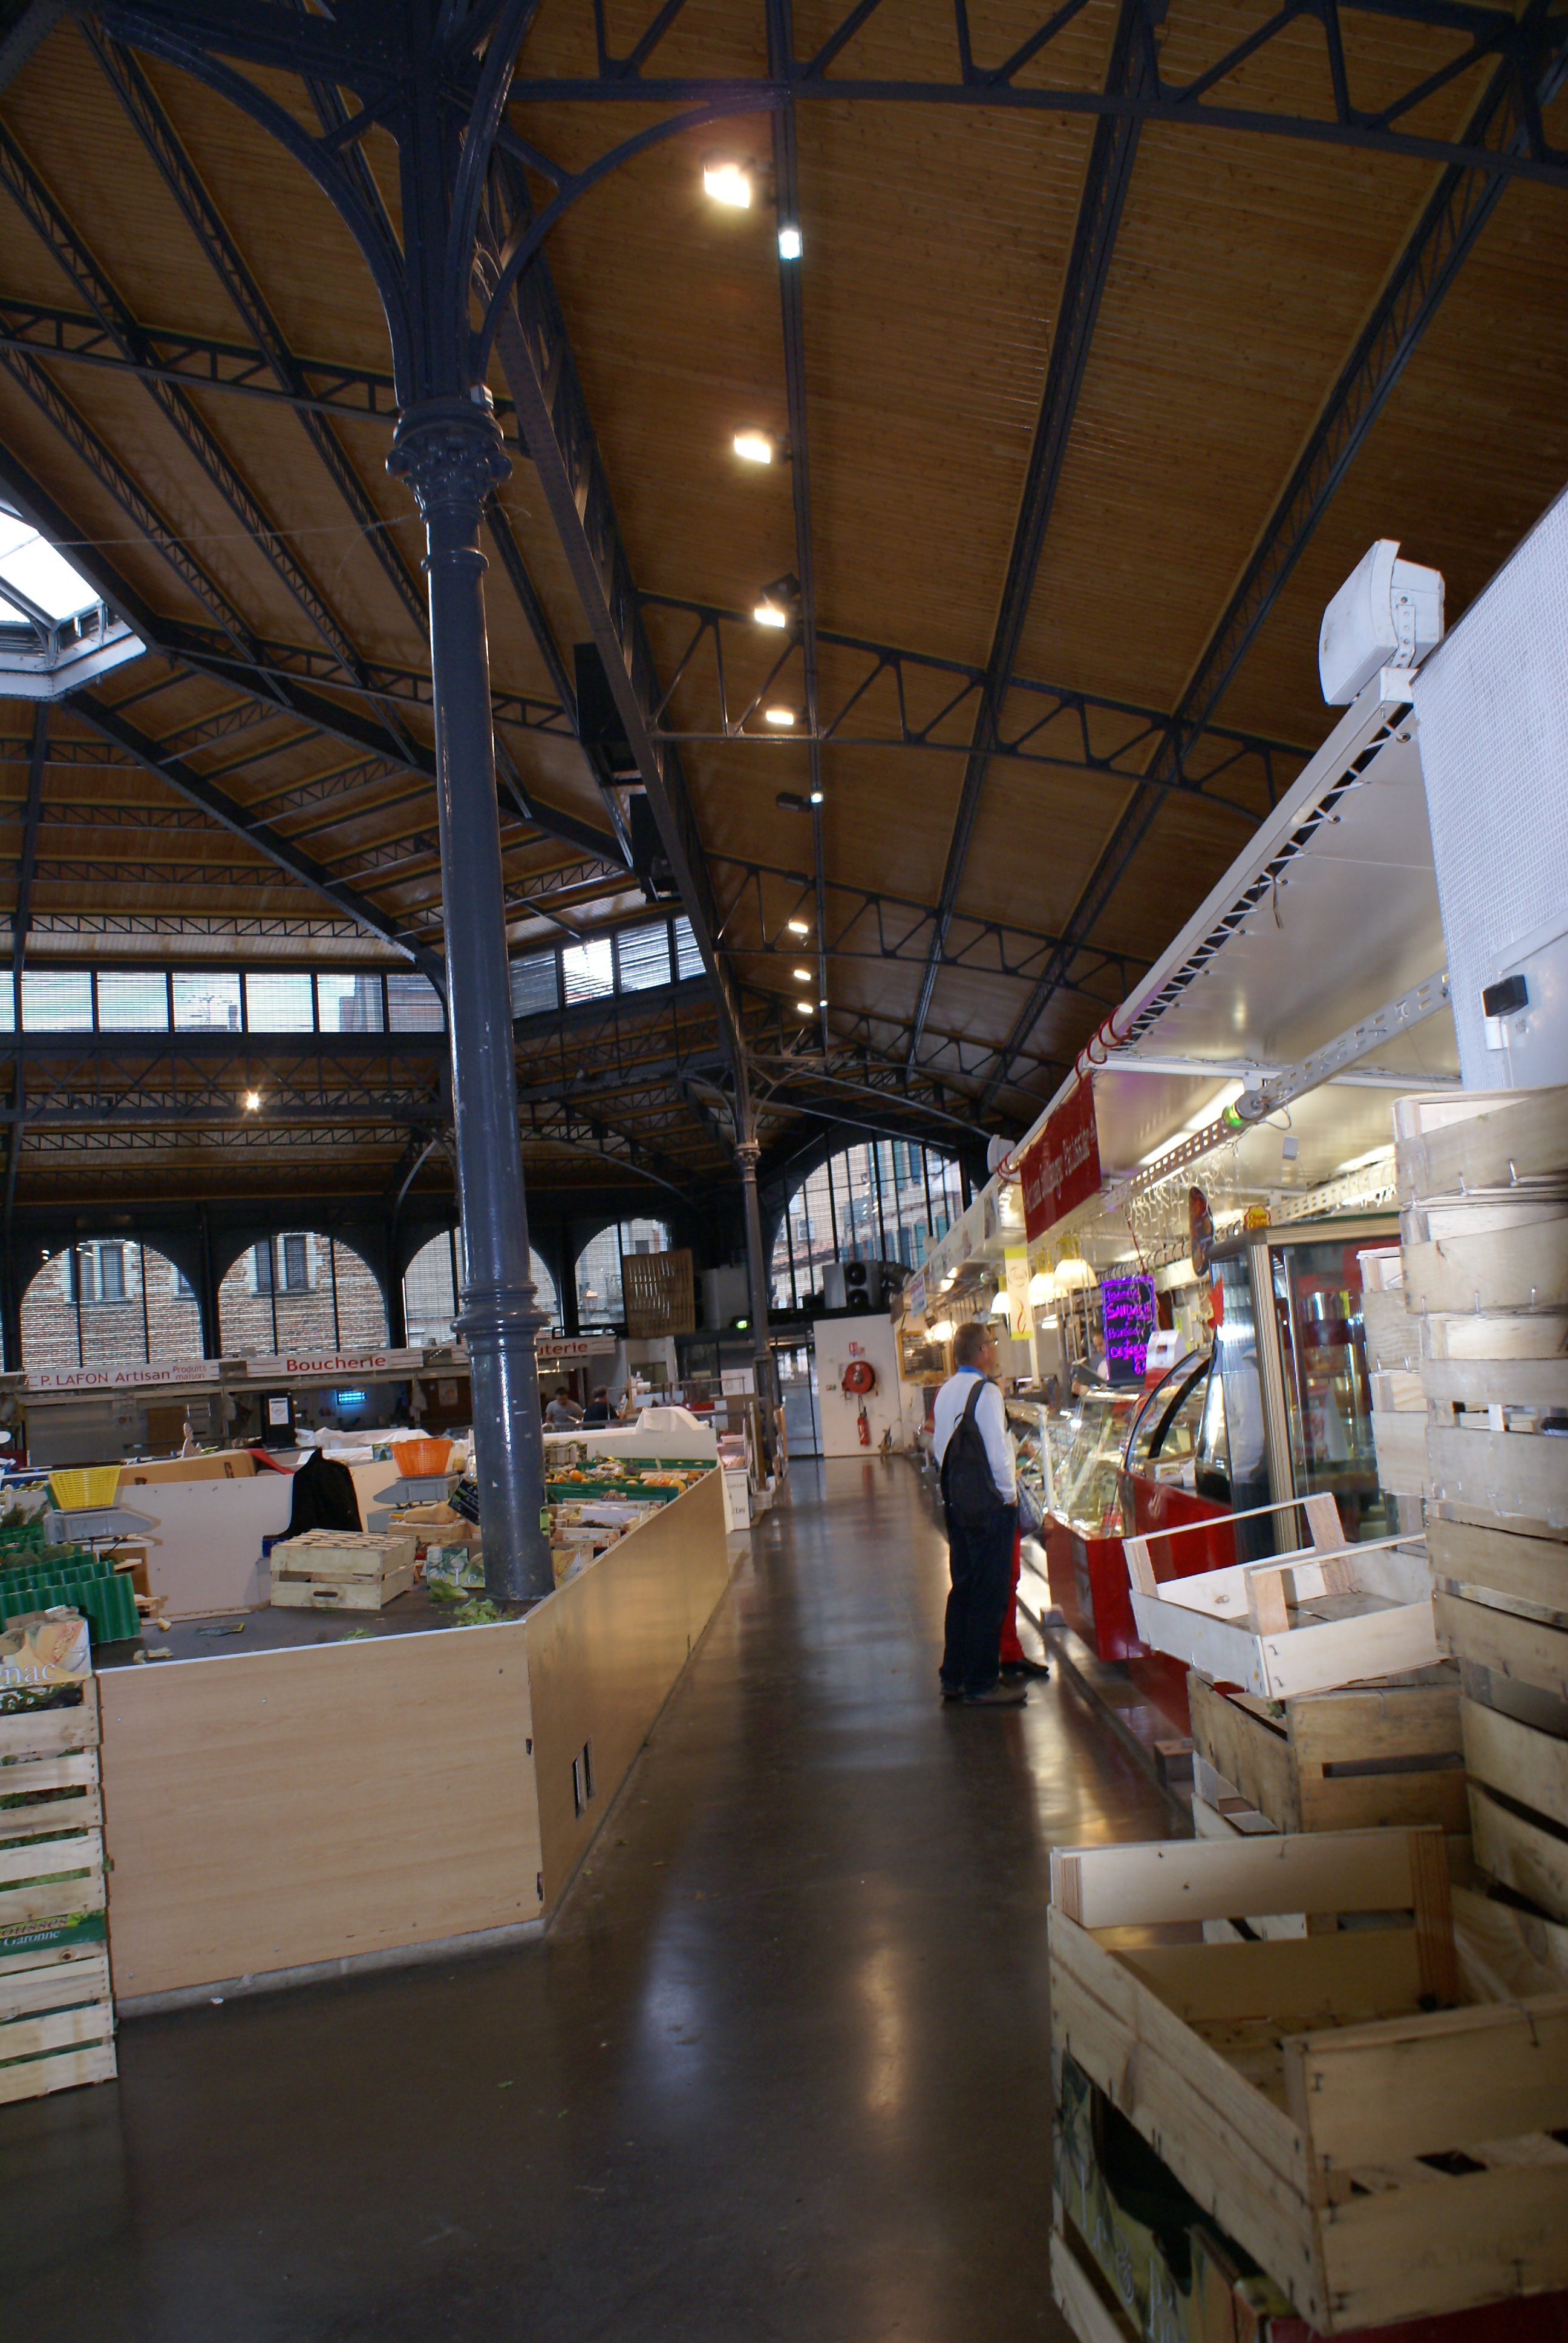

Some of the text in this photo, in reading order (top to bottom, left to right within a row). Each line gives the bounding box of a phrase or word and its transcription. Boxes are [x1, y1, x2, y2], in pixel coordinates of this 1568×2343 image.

[173, 1365, 207, 1374] Produits
[287, 1356, 387, 1372] Boucherie
[41, 1369, 171, 1386] P. LAFON Artisan
[454, 1568, 478, 1585] Le
[0, 1663, 57, 1685] nac
[0, 1915, 68, 1937] ousses
[4, 1930, 60, 1946] Garonne
